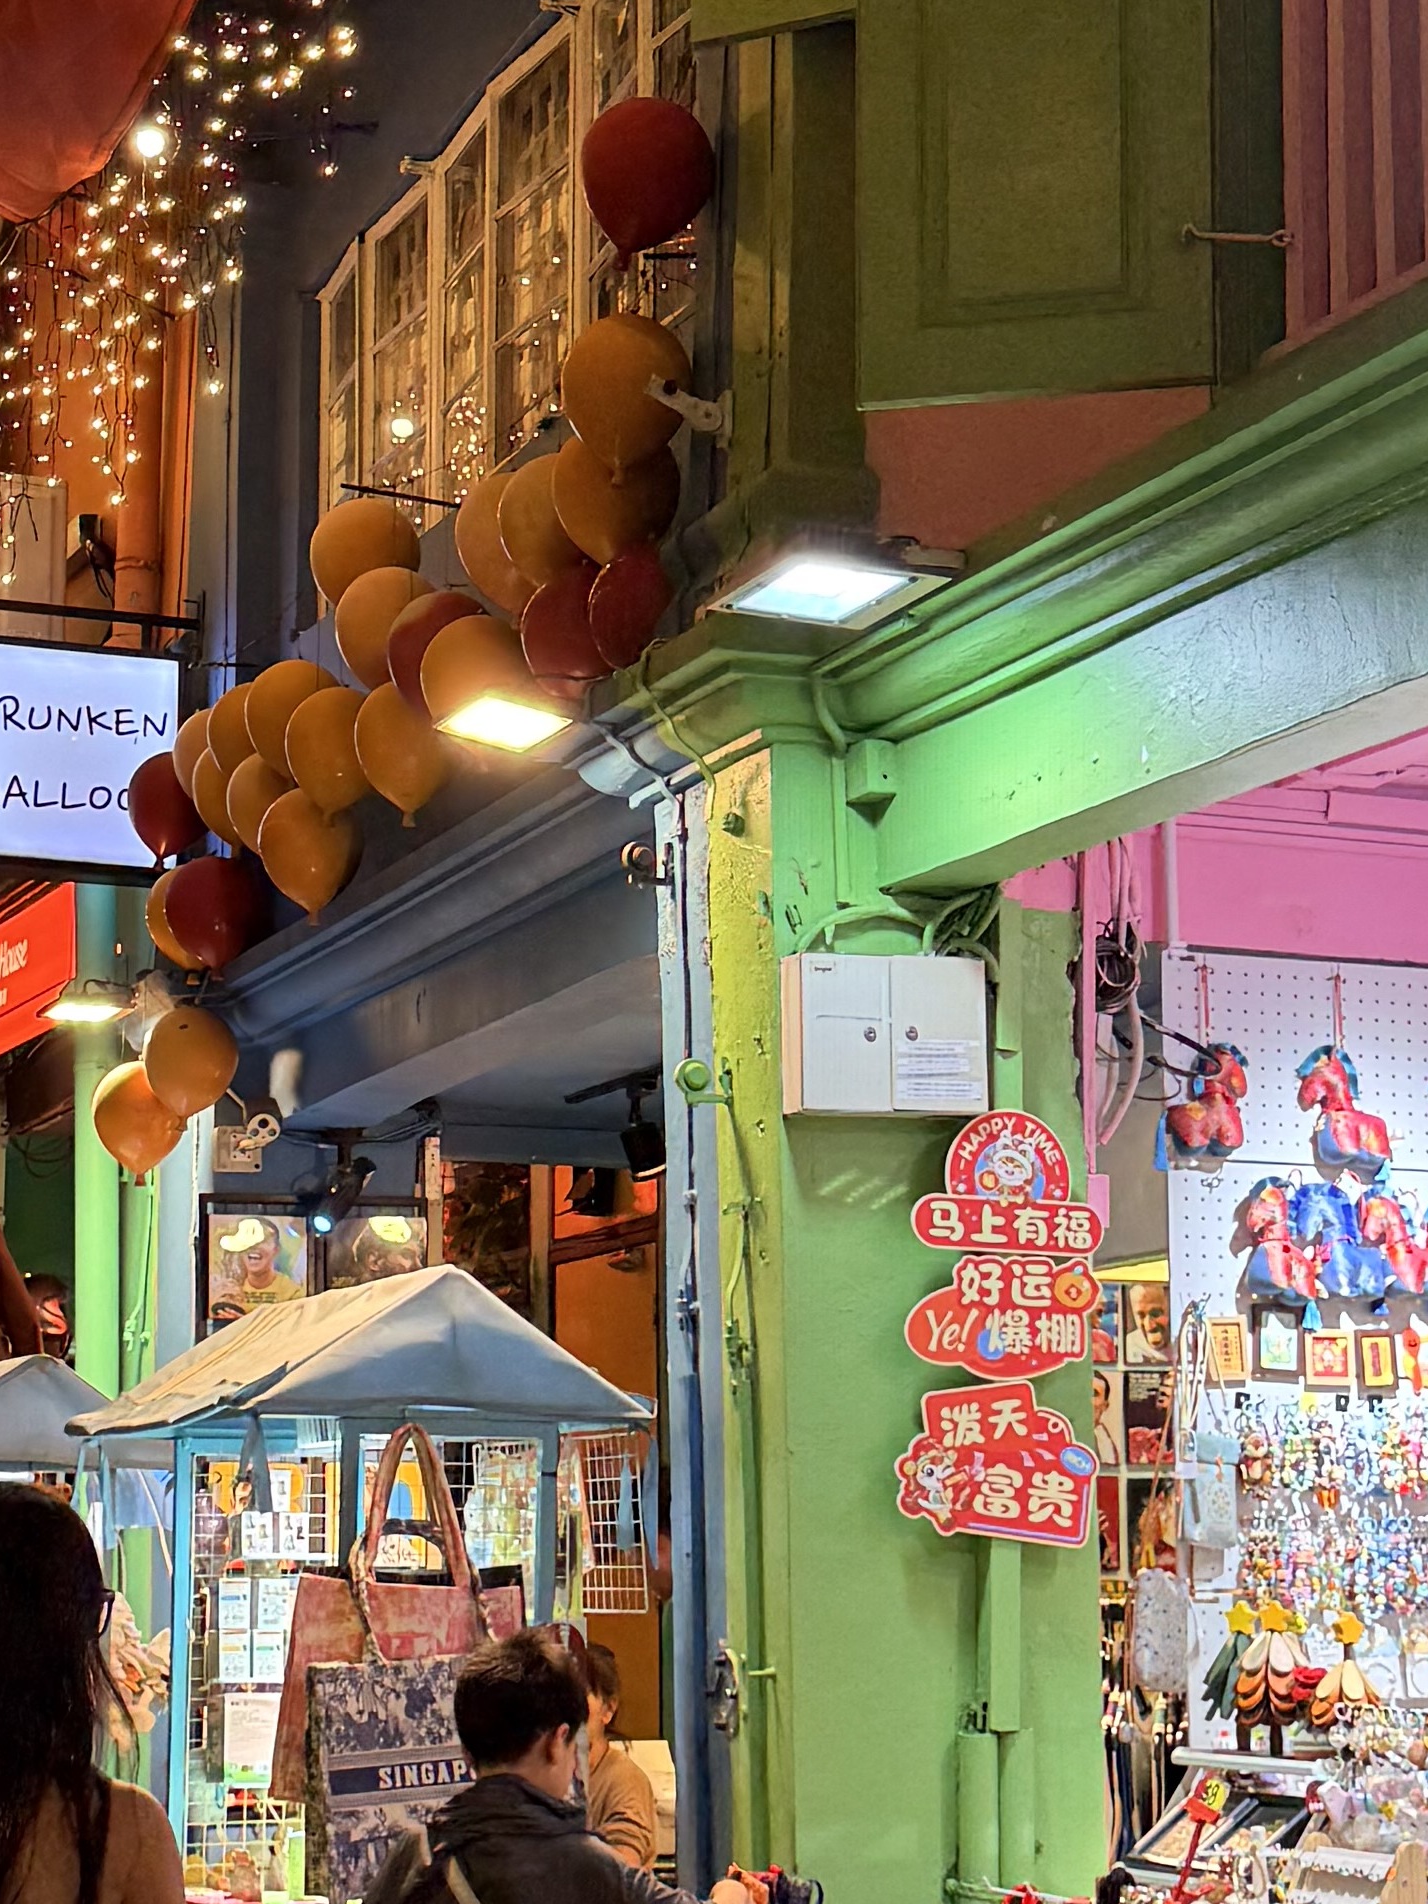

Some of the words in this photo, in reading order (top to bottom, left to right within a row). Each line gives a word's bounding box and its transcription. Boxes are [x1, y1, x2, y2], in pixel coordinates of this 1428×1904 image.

[957, 1116, 1017, 1161] HAPPY
[1024, 1121, 1061, 1166] TIME
[928, 1200, 1093, 1249] 马上有福
[960, 1262, 1052, 1307] 好运
[925, 1308, 980, 1353] Ye!
[985, 1308, 1081, 1355] 爆棚
[940, 1398, 1028, 1448] 泼天
[972, 1462, 1079, 1528] 富贵
